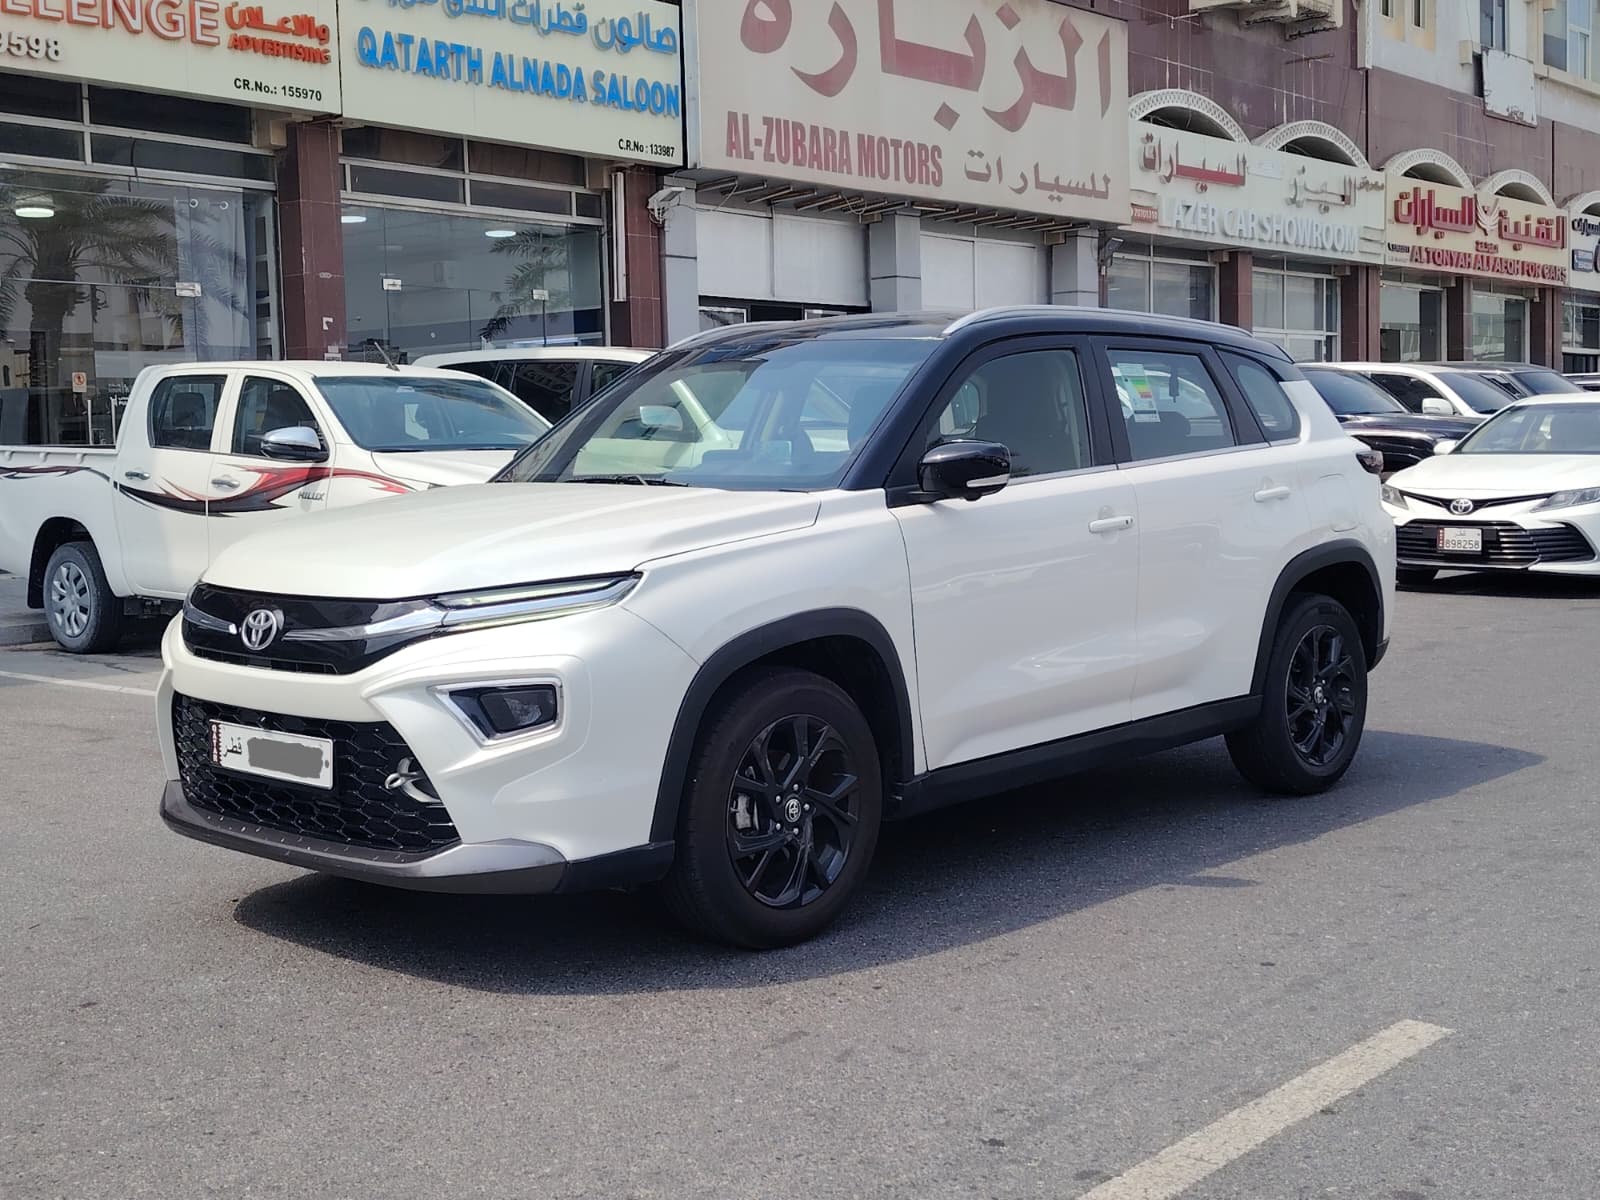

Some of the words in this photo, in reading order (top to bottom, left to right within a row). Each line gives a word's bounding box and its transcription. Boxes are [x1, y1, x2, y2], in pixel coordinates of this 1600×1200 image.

[228, 33, 332, 64] ADVERTISING
[592, 11, 678, 55] صالون
[356, 26, 484, 85] QATARTH
[491, 51, 588, 102] ALNADA
[591, 70, 680, 118] SALOON
[281, 85, 322, 101] 155970
[650, 144, 675, 157] 133987
[725, 110, 852, 175] AL-ZUBARA
[857, 133, 943, 188] MOTORS
[222, 736, 243, 758] قطر
